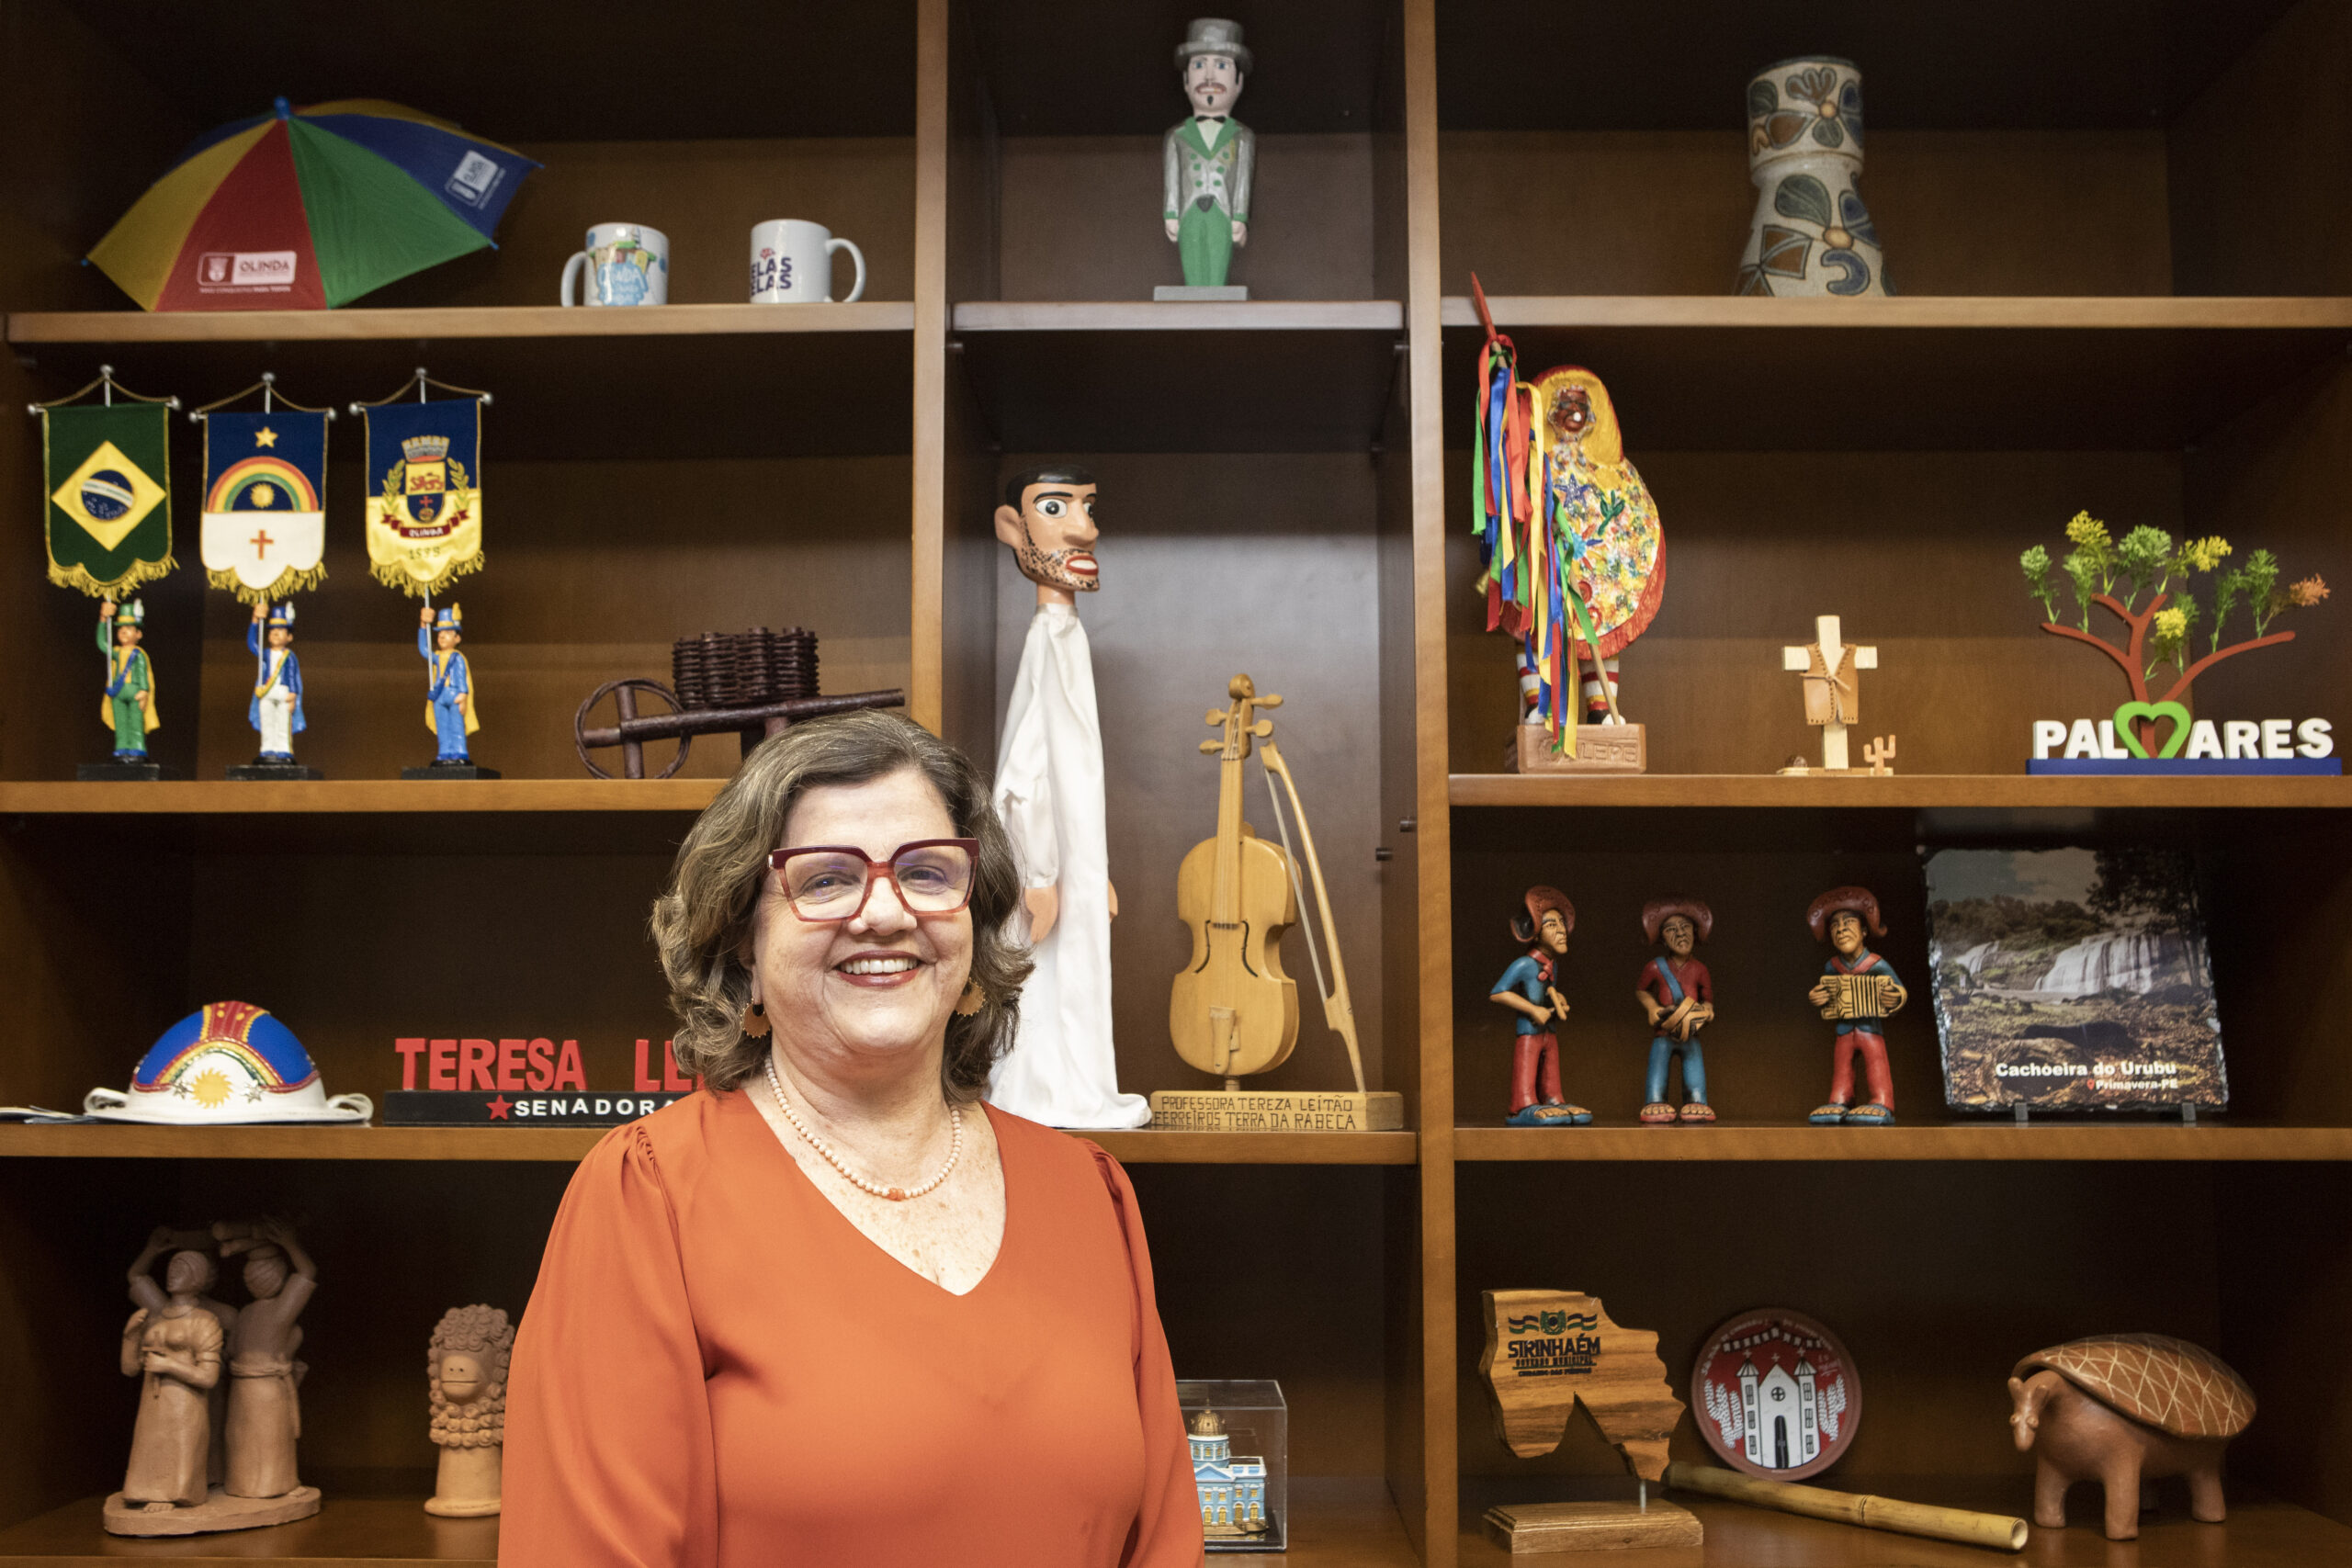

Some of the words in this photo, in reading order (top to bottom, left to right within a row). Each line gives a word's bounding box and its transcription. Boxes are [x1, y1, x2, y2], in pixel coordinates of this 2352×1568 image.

[240, 260, 289, 273] OLINDA
[409, 527, 444, 537] OLINDA
[1565, 740, 1638, 763] LEPE
[395, 1037, 588, 1091] TERESA
[634, 1039, 706, 1091] LE
[1996, 1062, 2087, 1077] Cachoeira
[2092, 1062, 2116, 1076] do
[2120, 1060, 2177, 1076] Urubu
[2096, 1077, 2178, 1090] Primavera-PE
[1161, 1096, 1235, 1111] PROFESSORA
[1238, 1097, 1292, 1111] TEREZA
[1154, 1110, 1220, 1126] FERREIROS
[1225, 1111, 1267, 1128] TERRA
[1271, 1112, 1290, 1128] DA
[1295, 1113, 1356, 1130] RABECA
[1508, 1333, 1600, 1359] SIRINHAÉM
